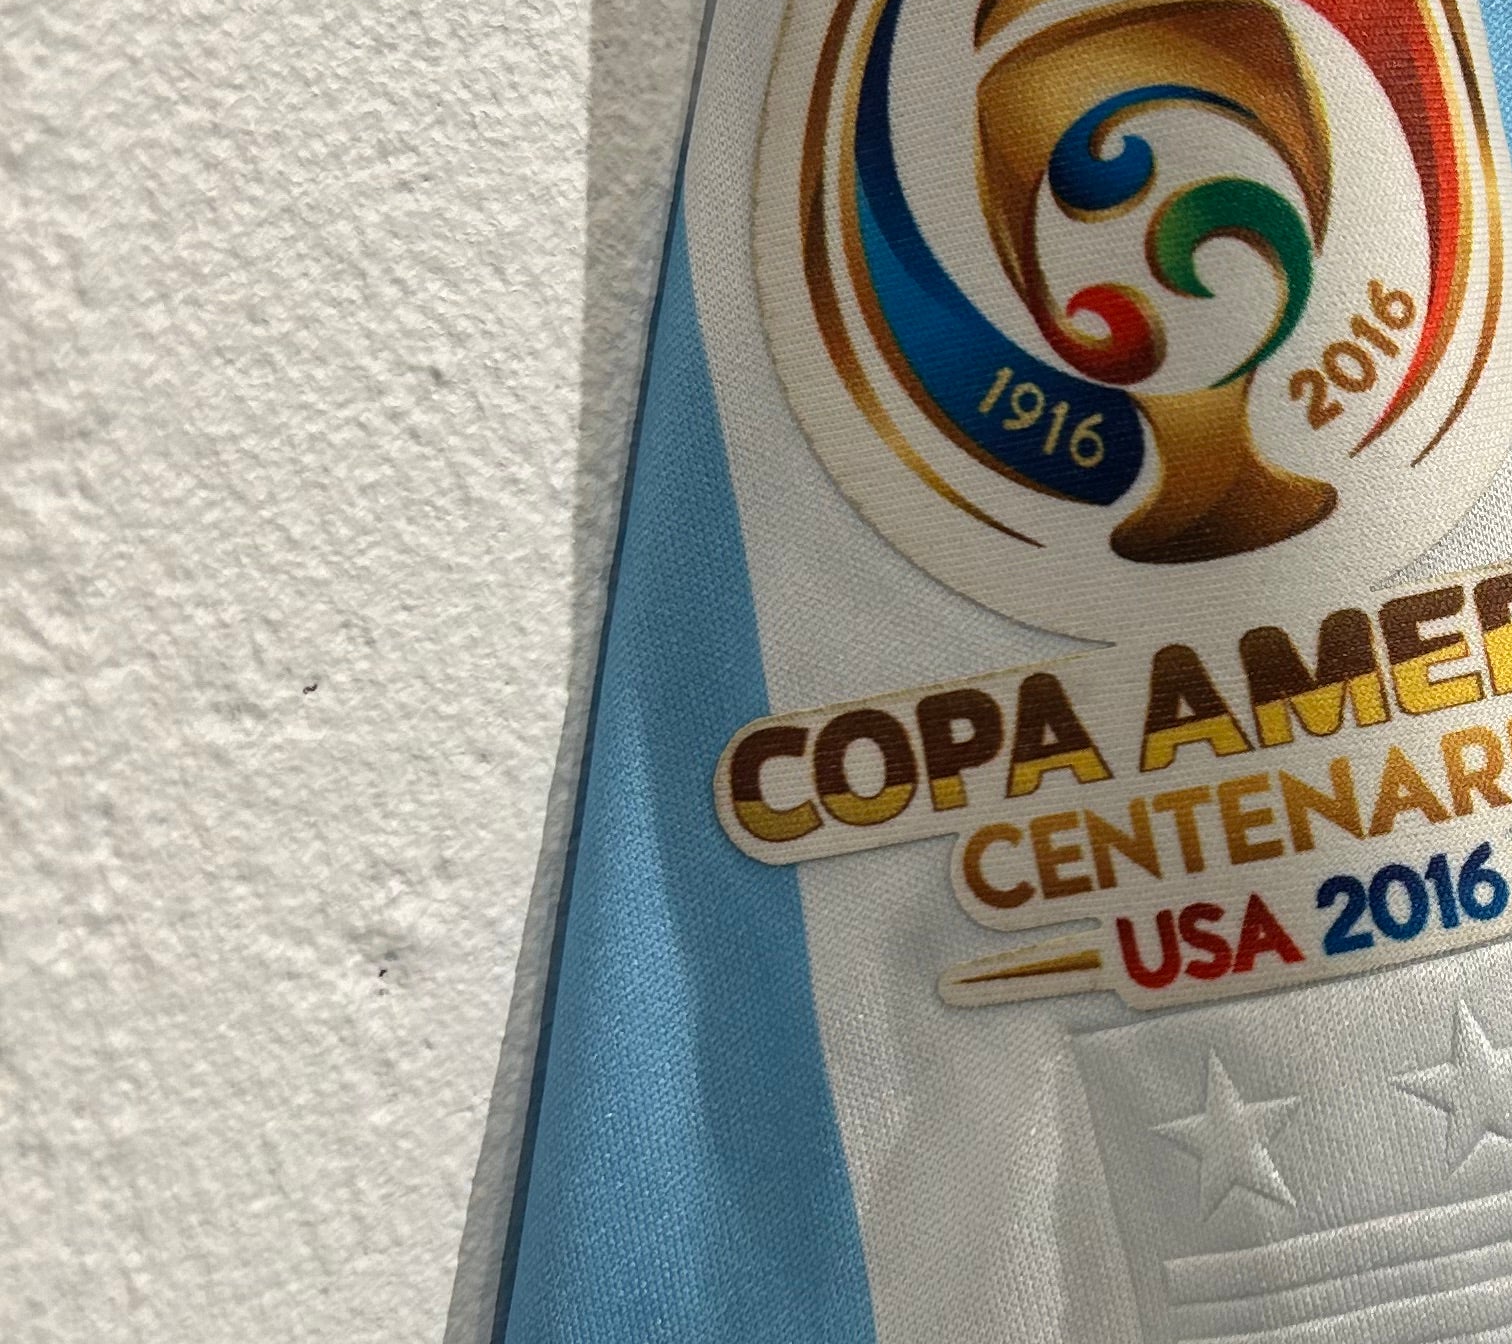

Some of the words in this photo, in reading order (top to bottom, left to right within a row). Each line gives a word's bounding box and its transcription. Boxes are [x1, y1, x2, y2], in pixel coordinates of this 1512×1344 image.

[977, 367, 1106, 468] 1916
[1289, 278, 1417, 431] 2016
[728, 672, 1111, 842] COPA
[1115, 892, 1305, 990] USA
[1313, 842, 1510, 958] 2016
